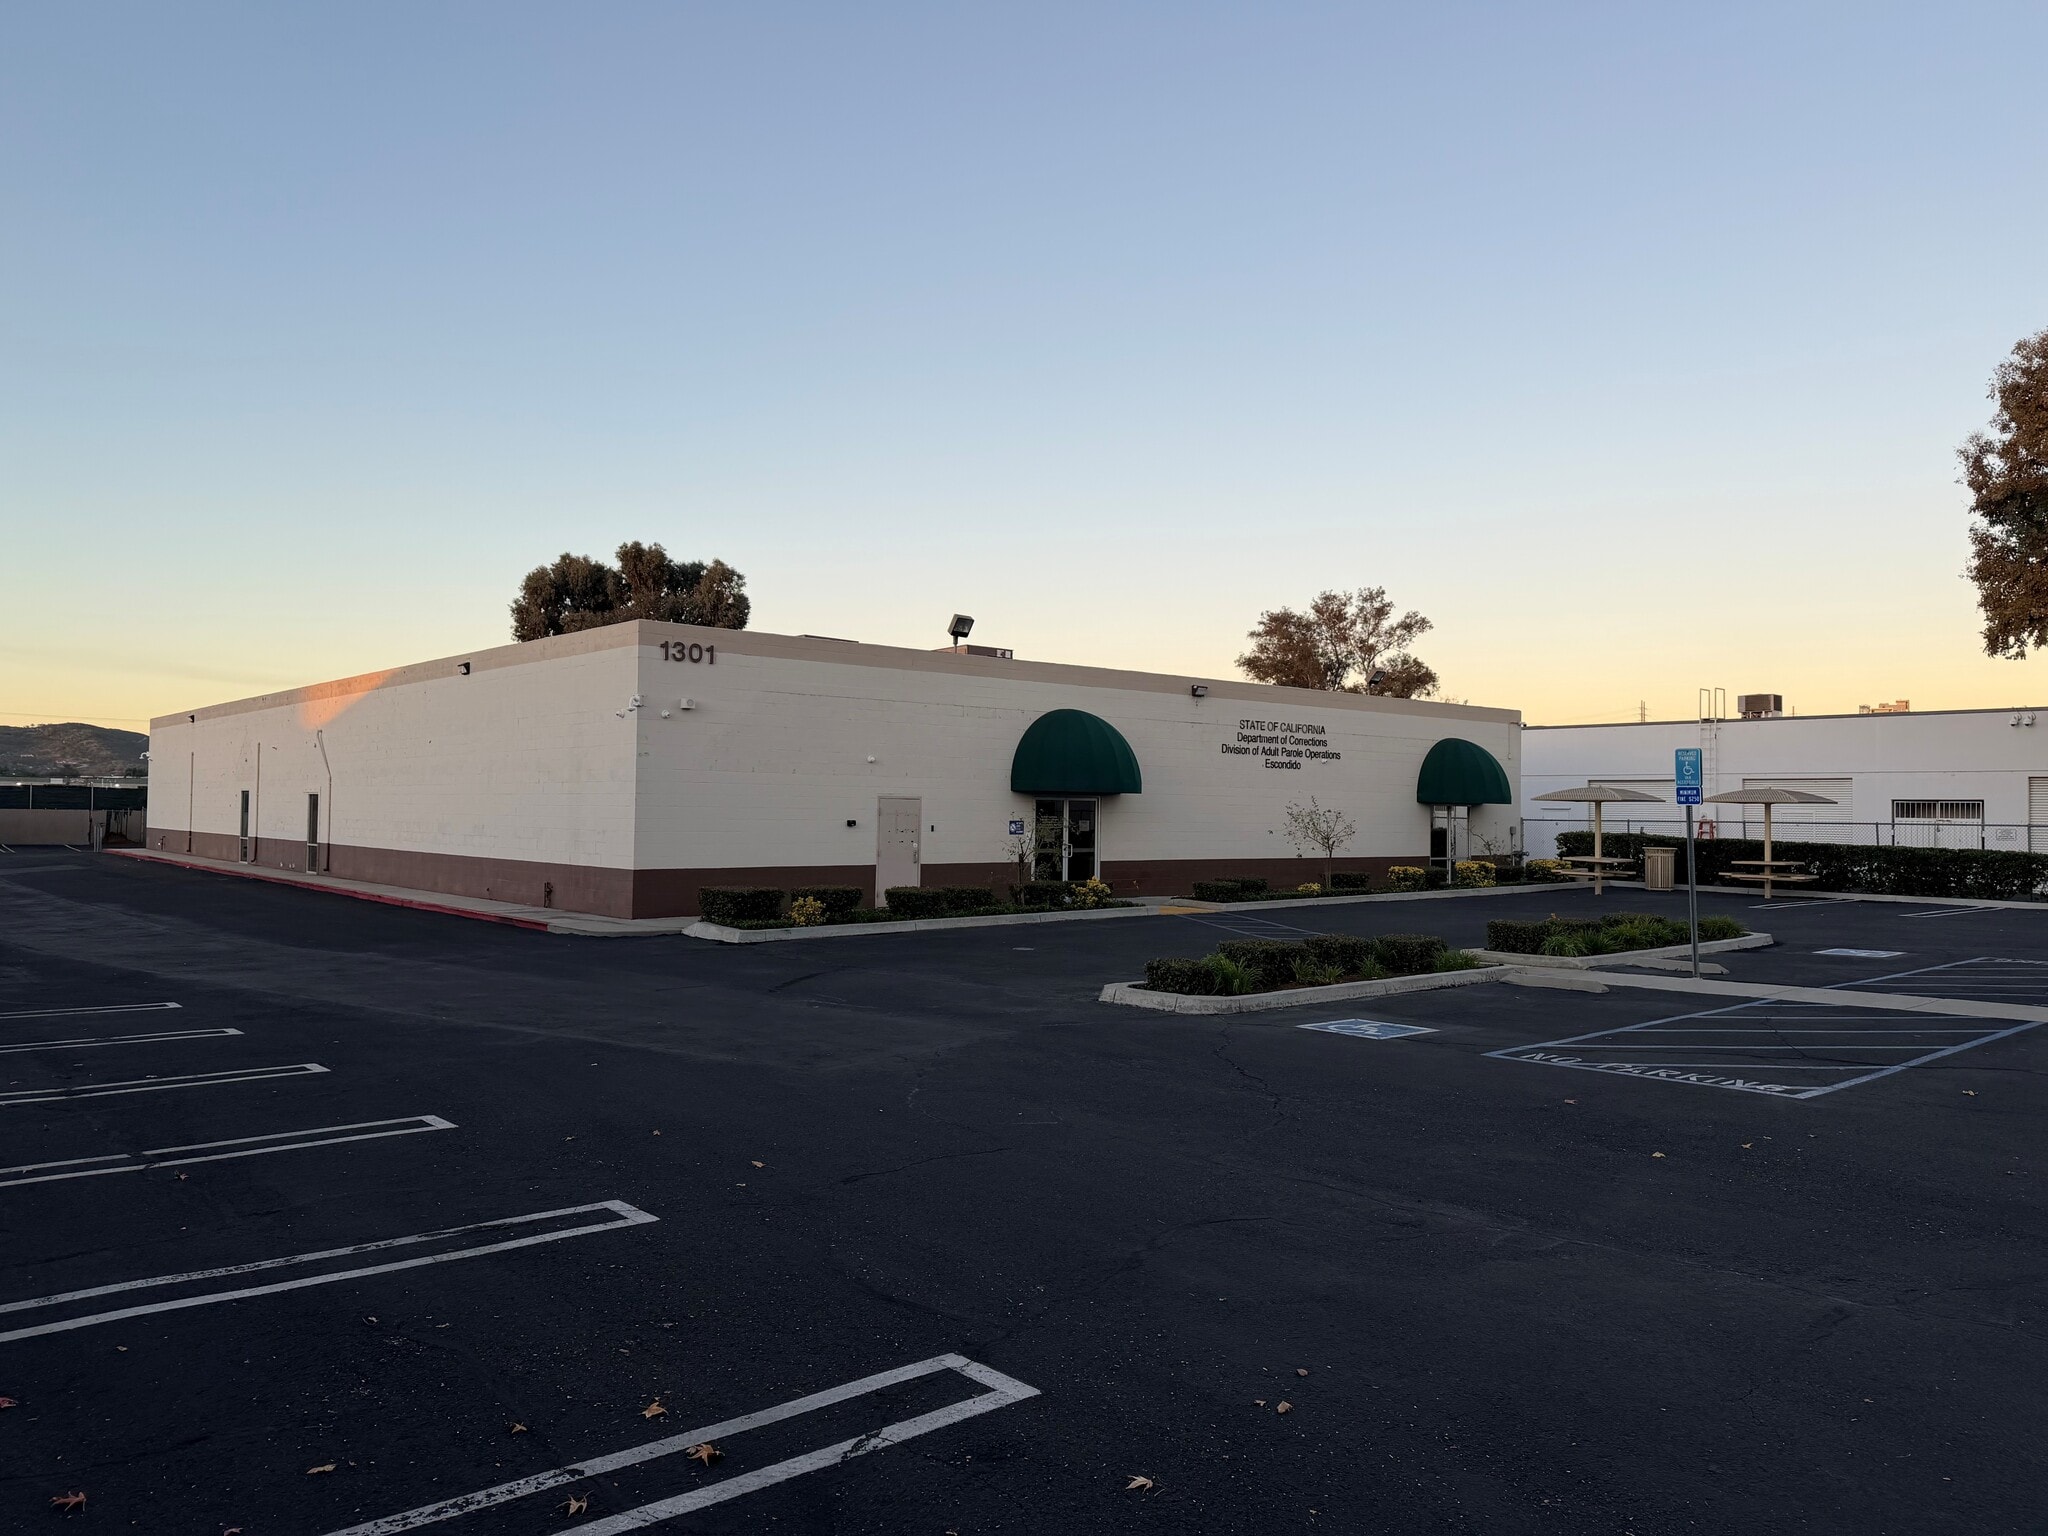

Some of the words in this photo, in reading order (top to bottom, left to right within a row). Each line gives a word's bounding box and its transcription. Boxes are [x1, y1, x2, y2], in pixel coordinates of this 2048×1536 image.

[660, 640, 714, 665] 1301
[1239, 719, 1266, 731] STATE
[1267, 721, 1279, 732] OF
[1280, 723, 1326, 735] CALIFORNIA
[1237, 732, 1279, 745] Department
[1280, 735, 1288, 745] of
[1289, 735, 1328, 747] Corrections
[1221, 744, 1251, 755] Division
[1252, 745, 1260, 756] of
[1261, 746, 1280, 757] Adult
[1281, 748, 1304, 758] Parole
[1304, 749, 1341, 760] Operations
[1265, 759, 1301, 770] Escondido
[1519, 1053, 1582, 1064] NO
[1596, 1063, 1791, 1092] PARKING
